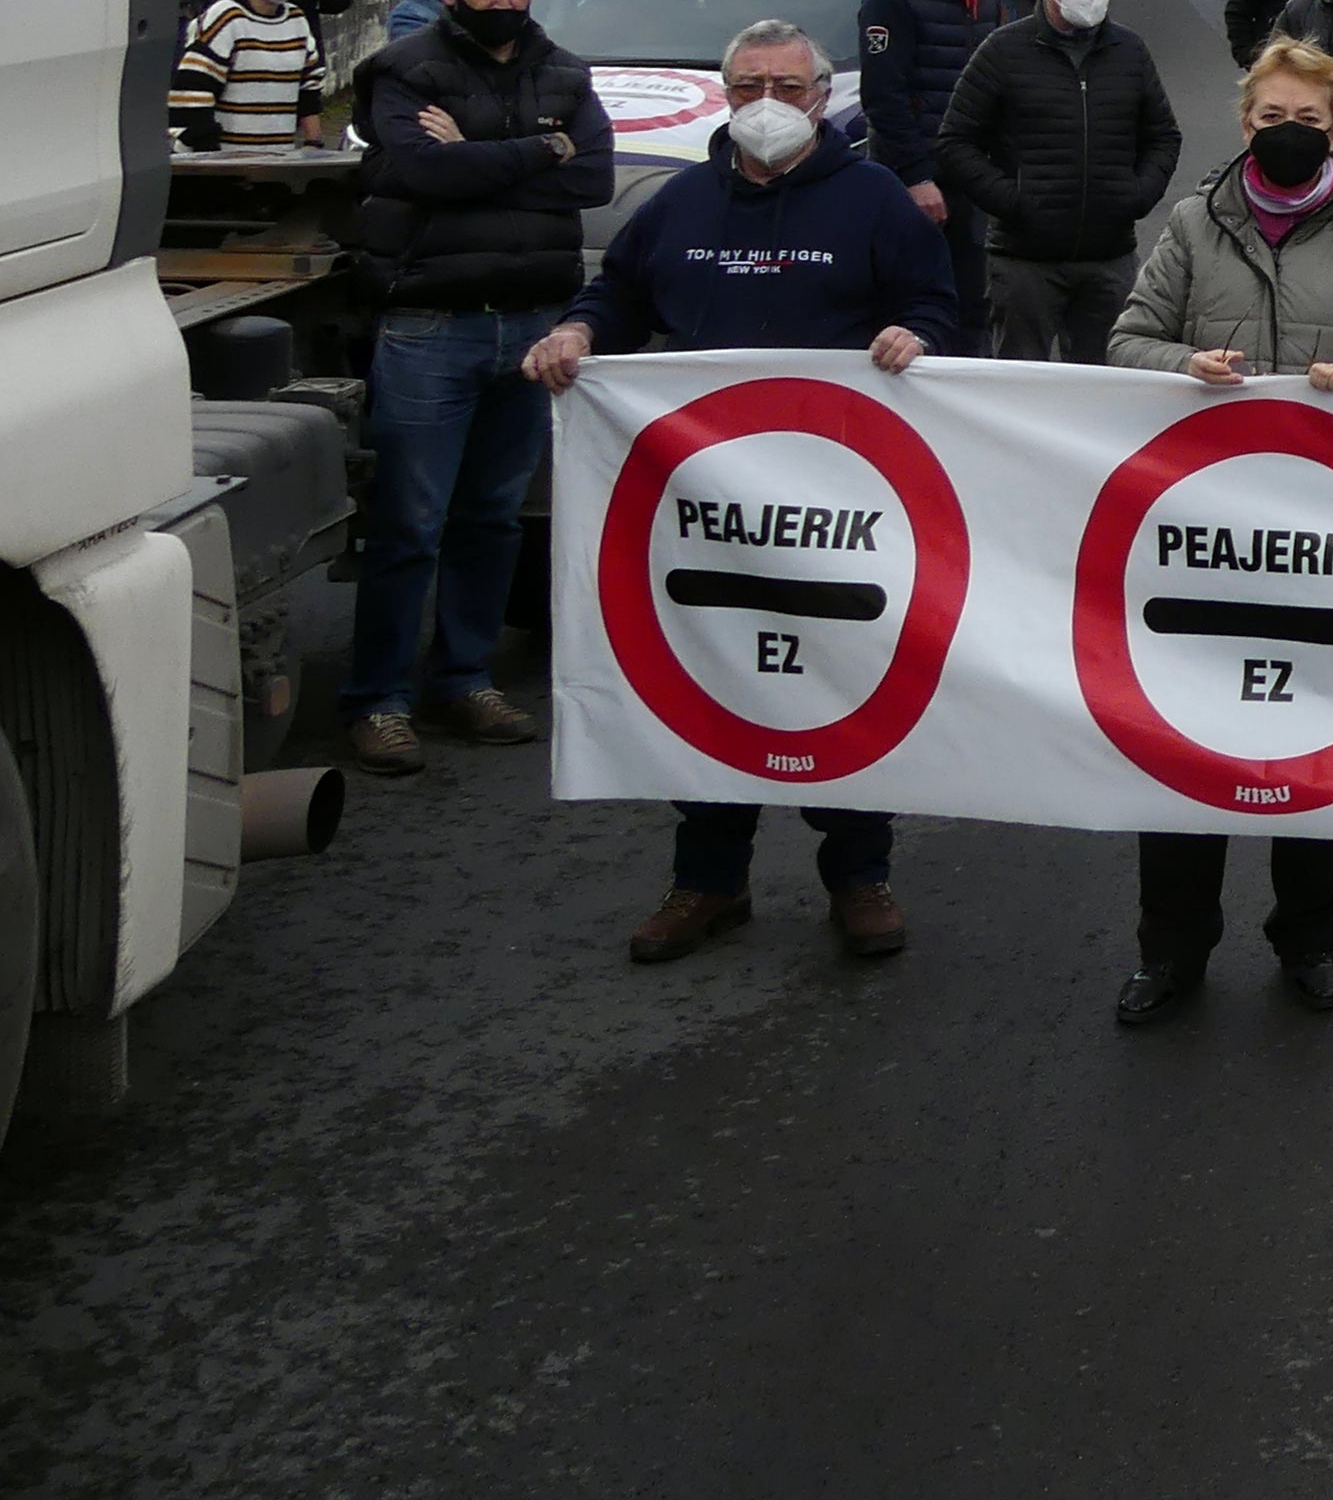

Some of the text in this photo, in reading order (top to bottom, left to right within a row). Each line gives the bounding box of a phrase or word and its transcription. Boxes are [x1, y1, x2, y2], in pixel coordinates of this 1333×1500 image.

[676, 498, 883, 551] PEAJERIK
[757, 631, 804, 674] EZ
[1240, 659, 1293, 702] EZ
